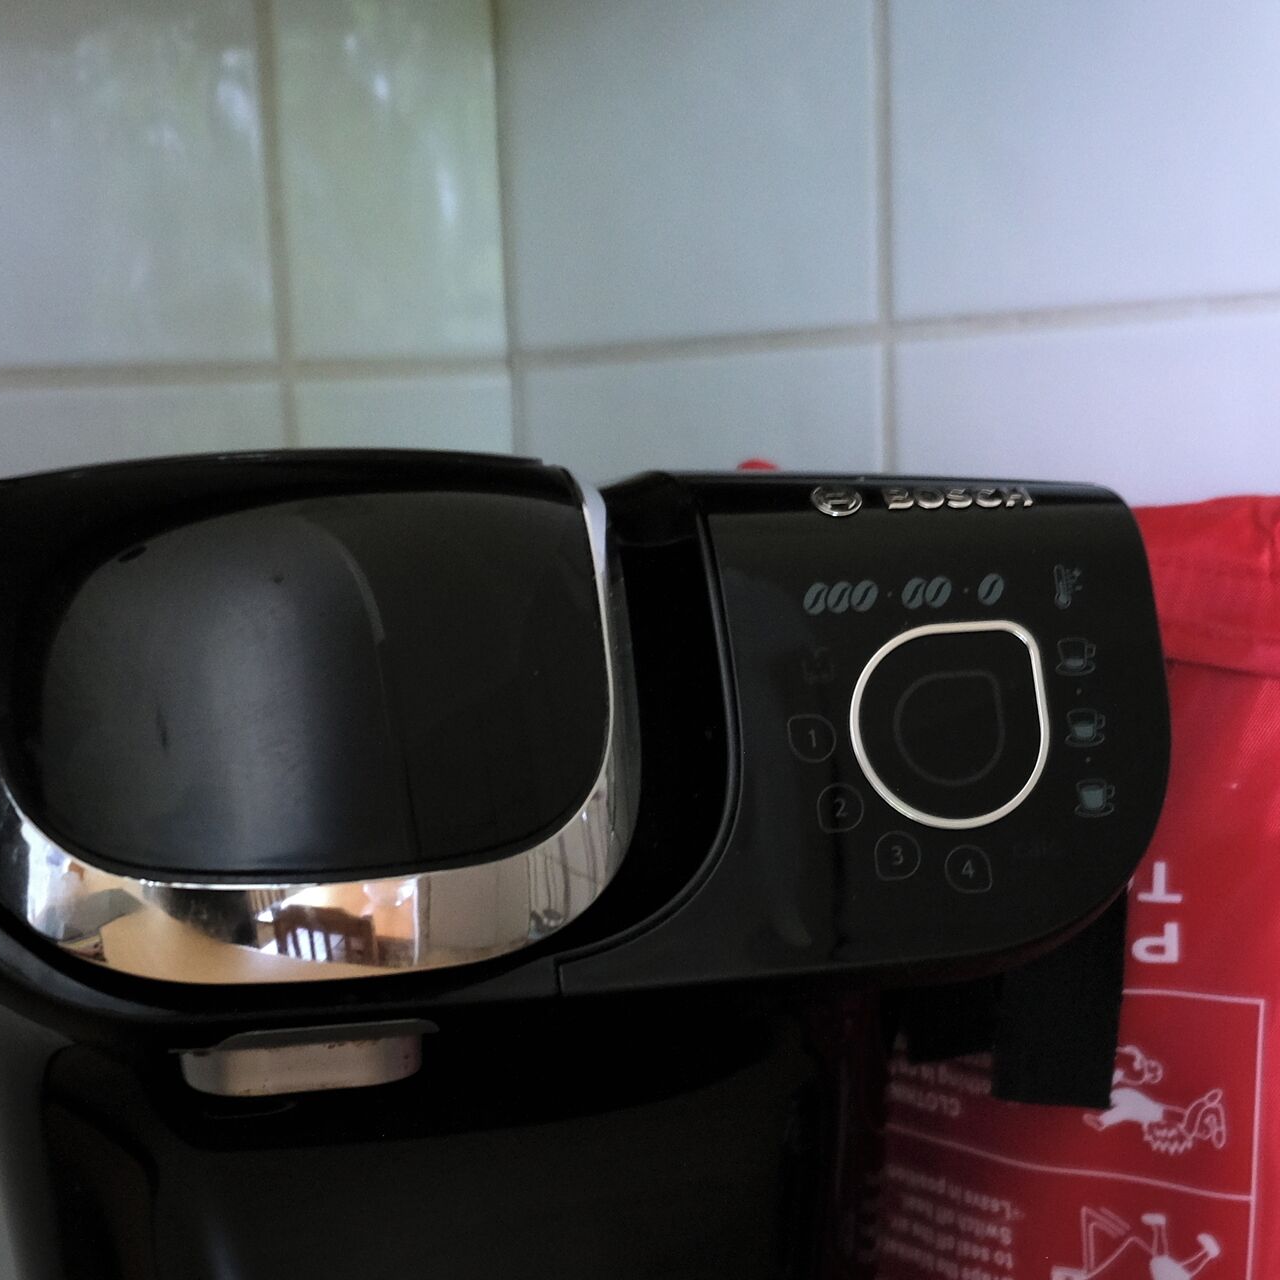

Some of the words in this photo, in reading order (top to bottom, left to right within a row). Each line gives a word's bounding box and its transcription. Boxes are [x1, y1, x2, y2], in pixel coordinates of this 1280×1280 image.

[883, 486, 1034, 511] BOSCH
[806, 730, 818, 748] 1
[833, 799, 849, 818] 2
[891, 844, 905, 867] 3
[960, 859, 975, 878] 4
